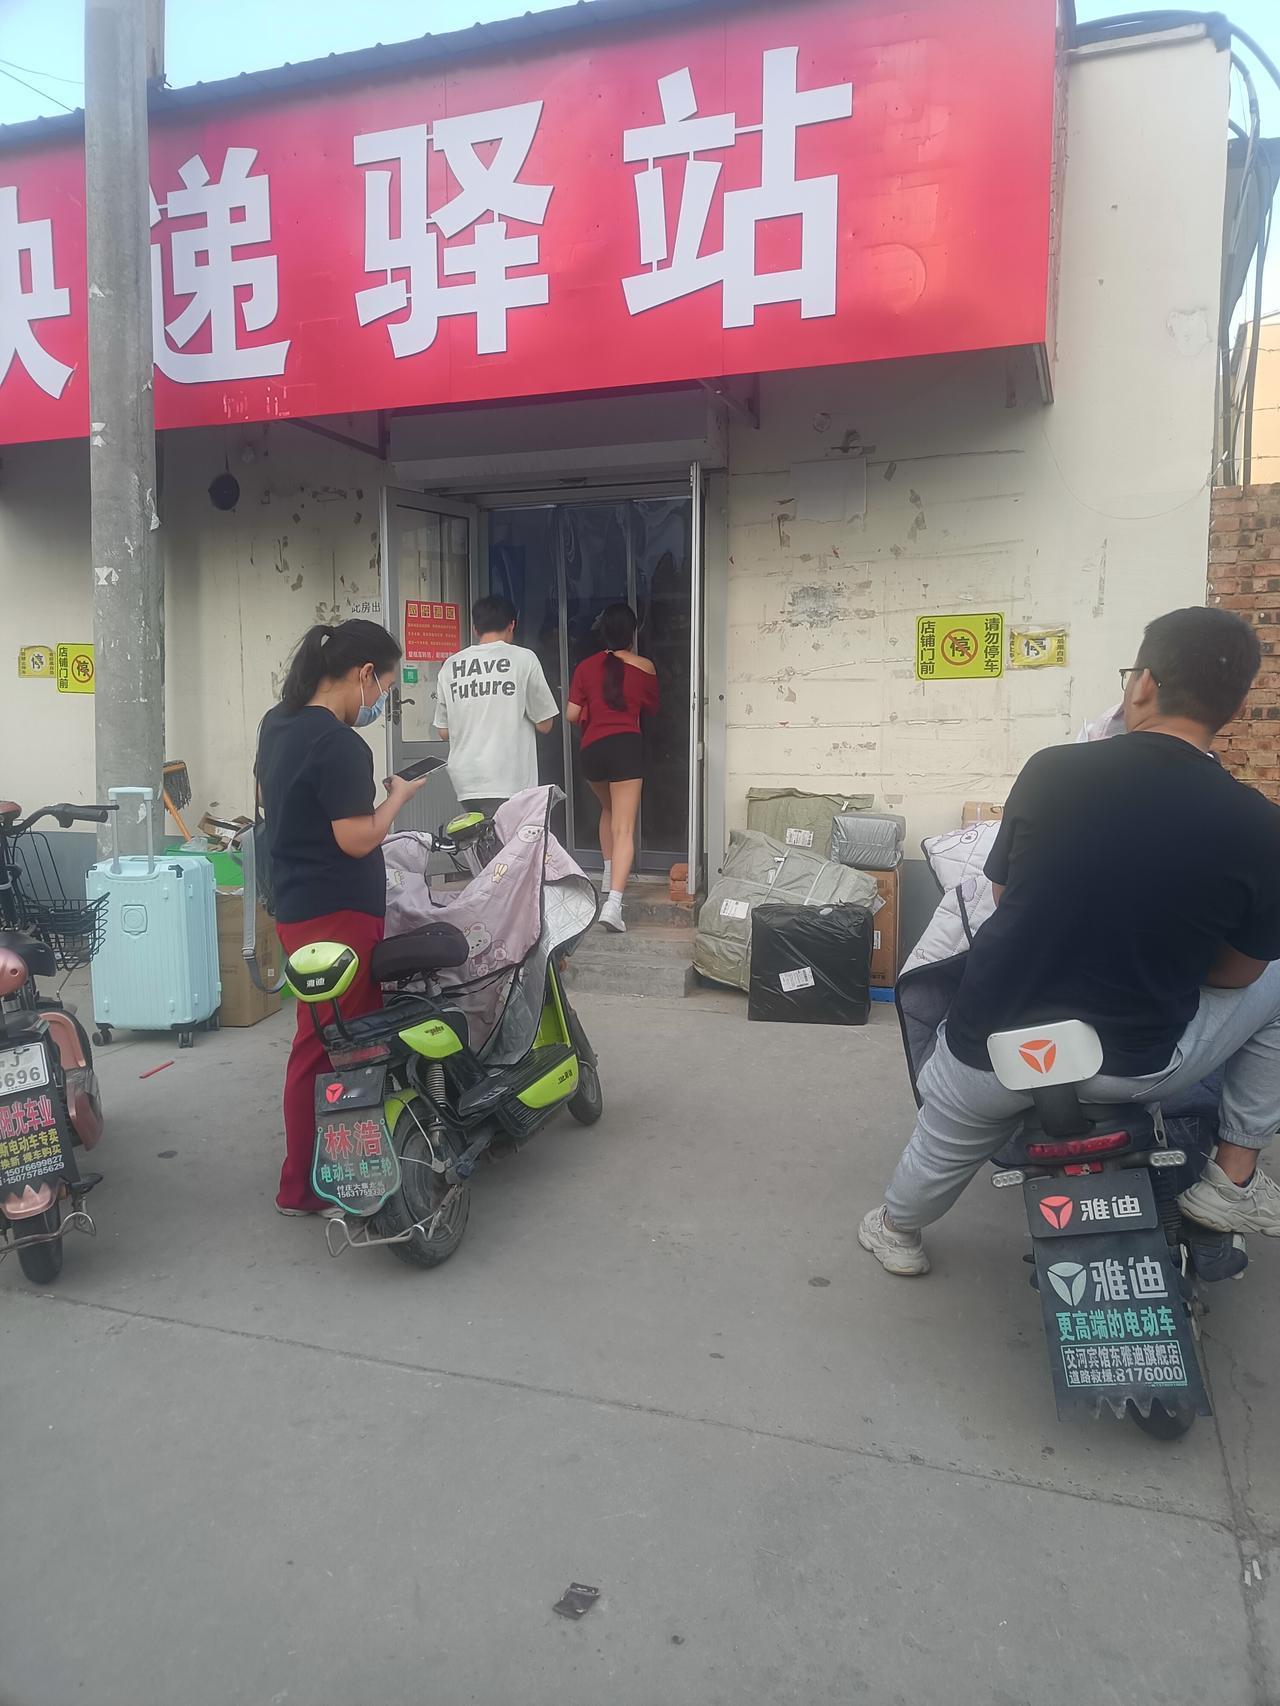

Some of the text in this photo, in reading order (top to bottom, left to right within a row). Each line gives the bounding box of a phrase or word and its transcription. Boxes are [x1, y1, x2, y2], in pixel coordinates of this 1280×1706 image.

[919, 620, 935, 675] 店铺门前
[949, 636, 971, 658] 停
[984, 618, 1000, 673] 请勿停车
[59, 647, 68, 688] 店铺门前
[452, 657, 511, 679] HAve
[450, 677, 516, 703] Future
[0, 1067, 41, 1089] 696
[323, 1119, 382, 1160] 林浩
[320, 1162, 355, 1183] 电动车
[1079, 1195, 1143, 1222] 雅迪
[1089, 1256, 1169, 1302] 雅迪
[1055, 1305, 1177, 1342] 更高端的电动车
